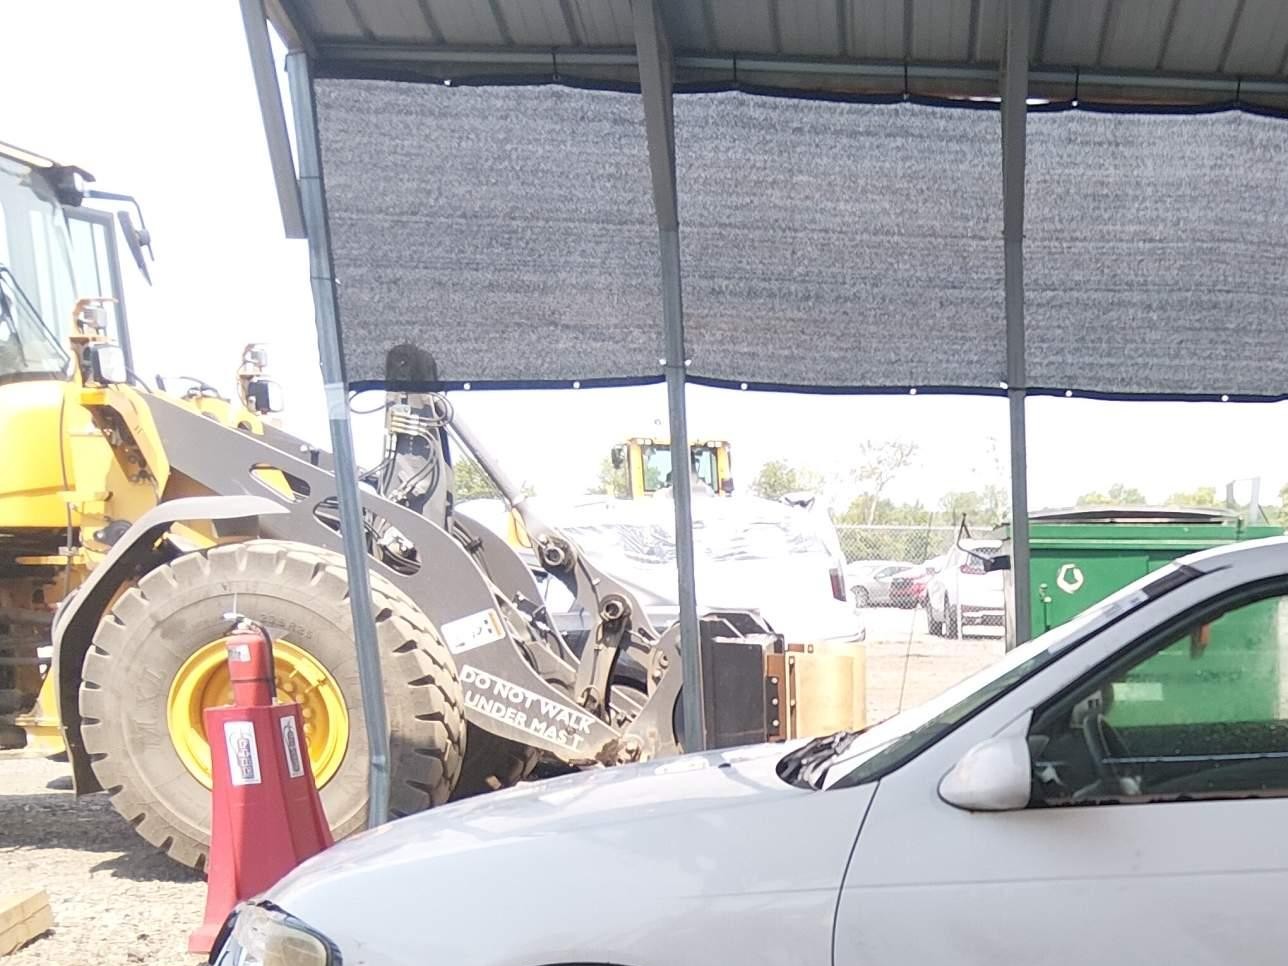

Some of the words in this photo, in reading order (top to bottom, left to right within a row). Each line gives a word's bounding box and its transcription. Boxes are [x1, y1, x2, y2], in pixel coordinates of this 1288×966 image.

[461, 664, 491, 689] DO
[493, 681, 538, 709] NOT
[540, 697, 595, 734] WALK
[465, 690, 527, 728] UNDER
[530, 718, 584, 750] MAST
